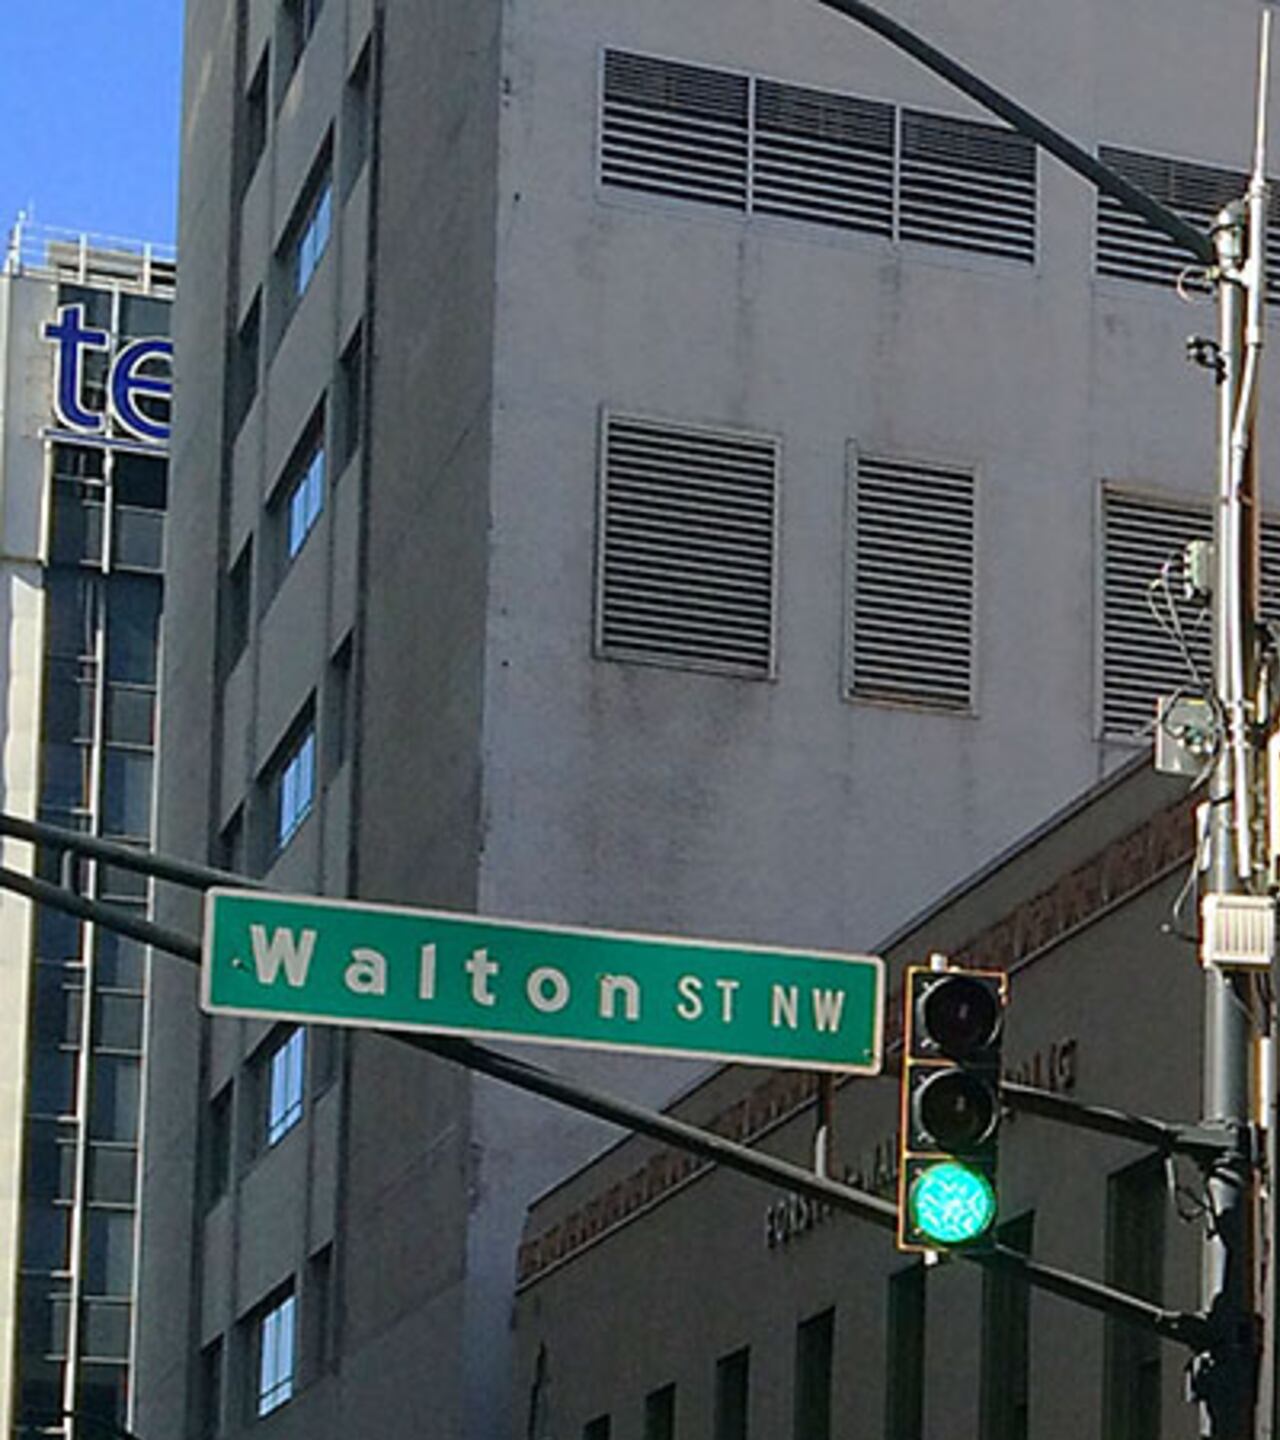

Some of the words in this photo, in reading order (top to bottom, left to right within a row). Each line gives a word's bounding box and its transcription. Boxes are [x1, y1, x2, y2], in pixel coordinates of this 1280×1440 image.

[249, 925, 640, 1021] Walton
[677, 976, 739, 1022] ST
[771, 986, 845, 1032] NW
